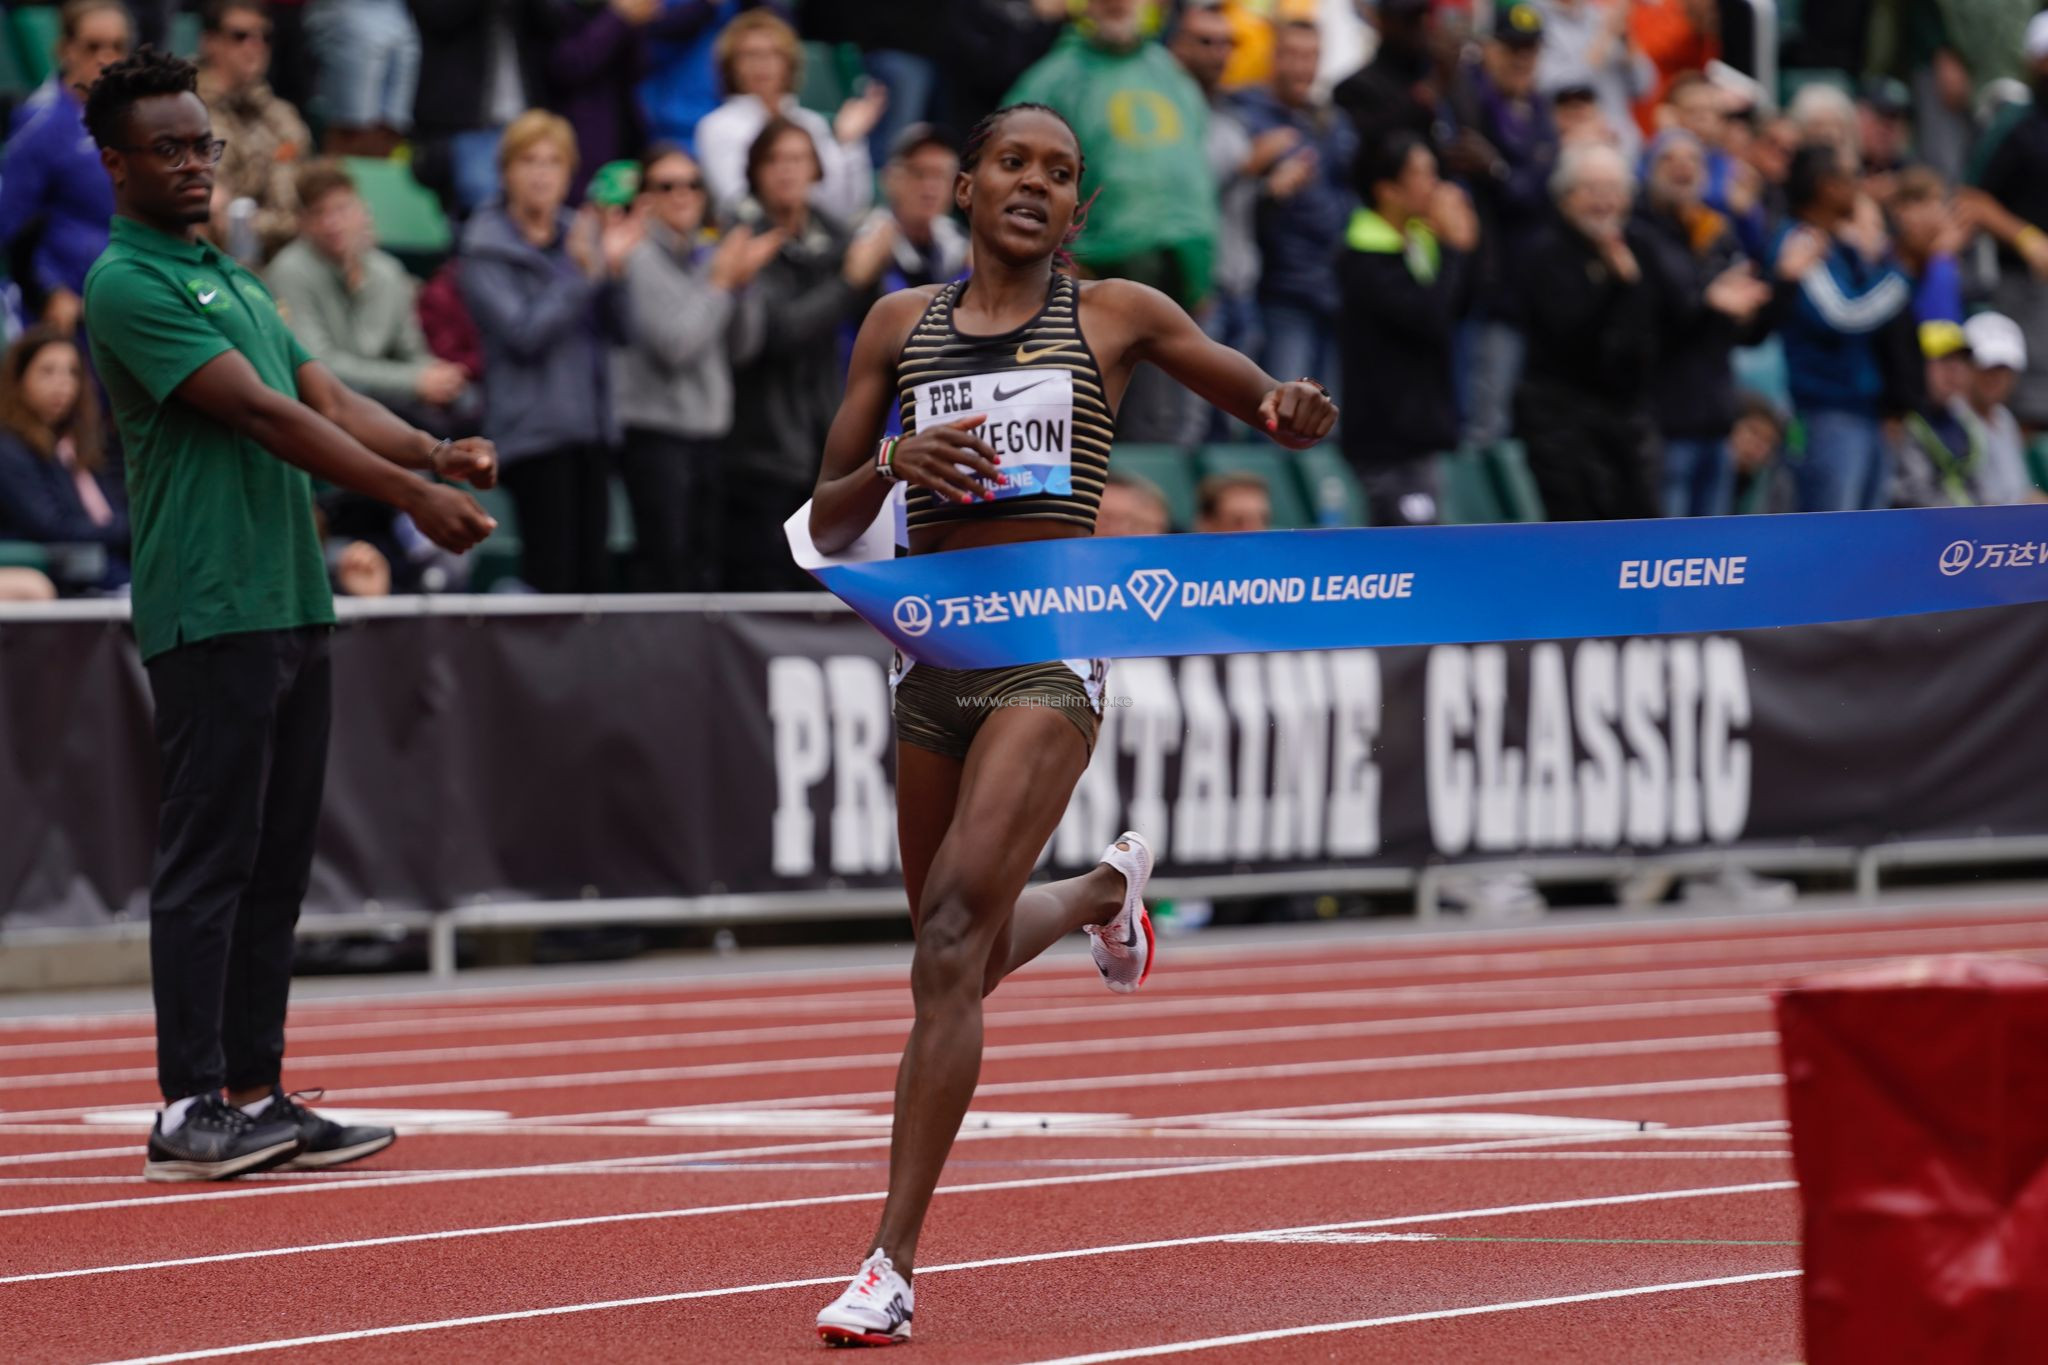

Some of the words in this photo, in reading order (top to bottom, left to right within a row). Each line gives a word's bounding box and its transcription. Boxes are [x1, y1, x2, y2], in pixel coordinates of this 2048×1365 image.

[929, 380, 973, 416] PRE
[1618, 556, 1748, 590] EUGENE
[1009, 583, 1128, 618] WANDA
[1181, 576, 1306, 608] DIAMOND
[1311, 572, 1416, 602] LEAGUE
[767, 648, 1383, 878] PRNTAINE
[1425, 634, 1753, 856] CLASSIC
